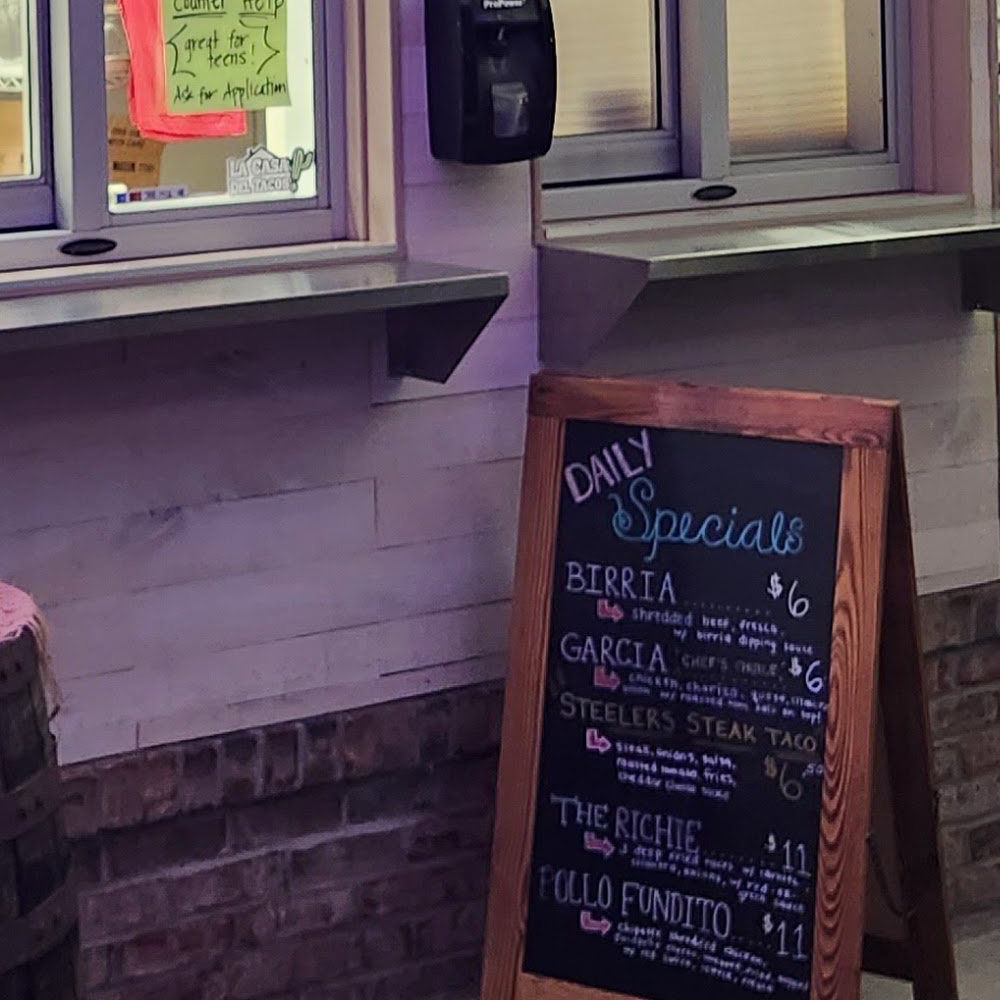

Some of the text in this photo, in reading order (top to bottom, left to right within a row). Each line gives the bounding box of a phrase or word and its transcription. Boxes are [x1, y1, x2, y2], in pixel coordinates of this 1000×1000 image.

[184, 31, 248, 63] great for
[173, 76, 287, 106] Ask for Application
[229, 157, 290, 177] LA CASA
[252, 176, 290, 192] TACOS
[564, 428, 652, 503] DAILY
[608, 477, 804, 562] Specials
[565, 561, 809, 618] BIRRIA $6
[632, 607, 693, 627] shredded
[560, 632, 668, 673] GARCIA
[738, 635, 777, 654] dipping
[560, 692, 817, 751] STEELERS STEAK TACO
[551, 792, 609, 828] THE
[615, 805, 701, 853] RICHIE
[540, 865, 612, 909] POLLO
[621, 881, 732, 939] FUNDITO
